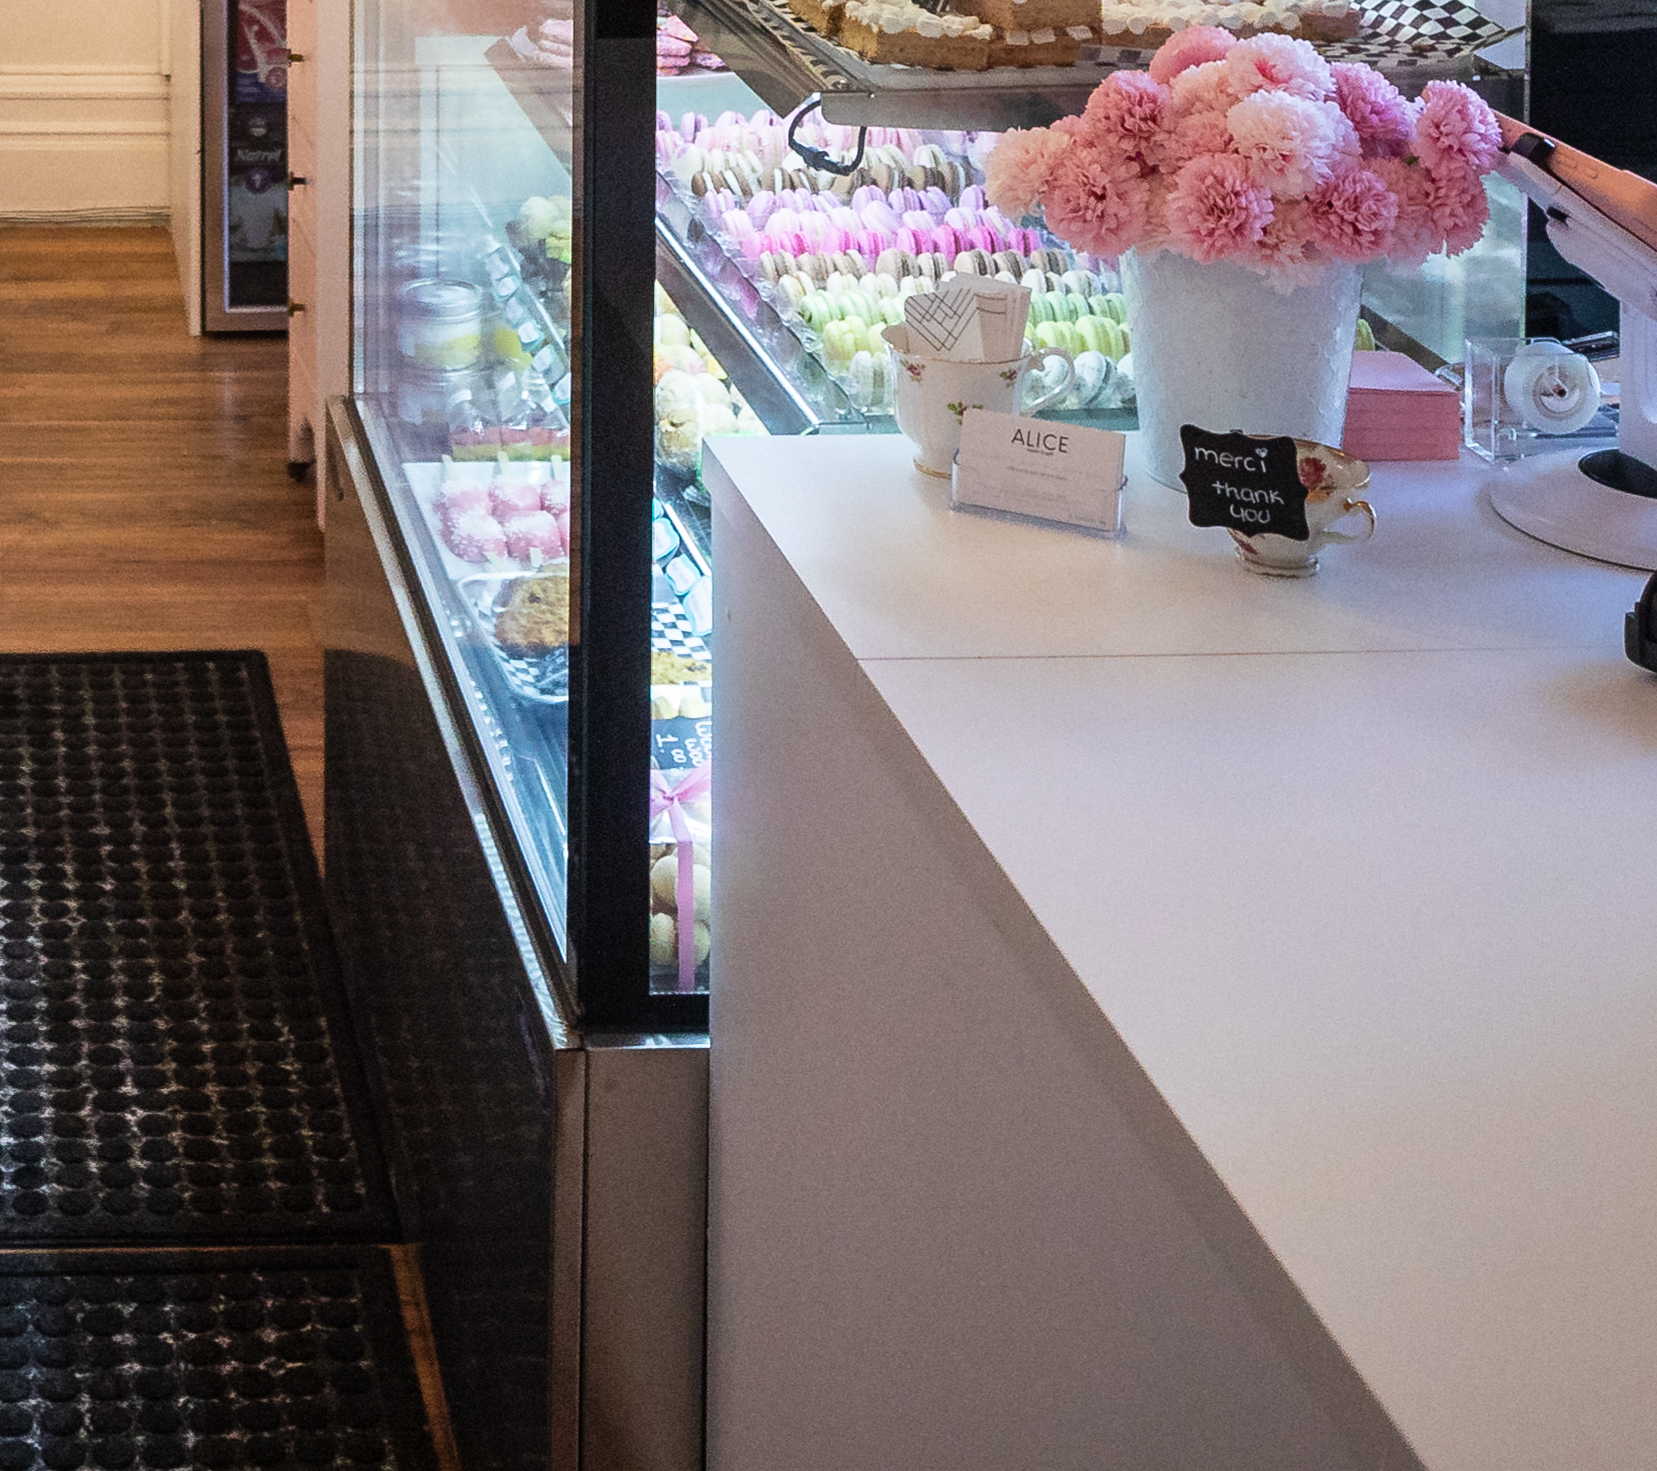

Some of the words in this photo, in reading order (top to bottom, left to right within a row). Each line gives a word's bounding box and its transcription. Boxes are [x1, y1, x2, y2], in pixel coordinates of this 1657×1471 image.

[1011, 428, 1069, 454] ALICE
[1195, 447, 1268, 473] merci
[1212, 481, 1285, 505] thank
[1230, 504, 1270, 524] you
